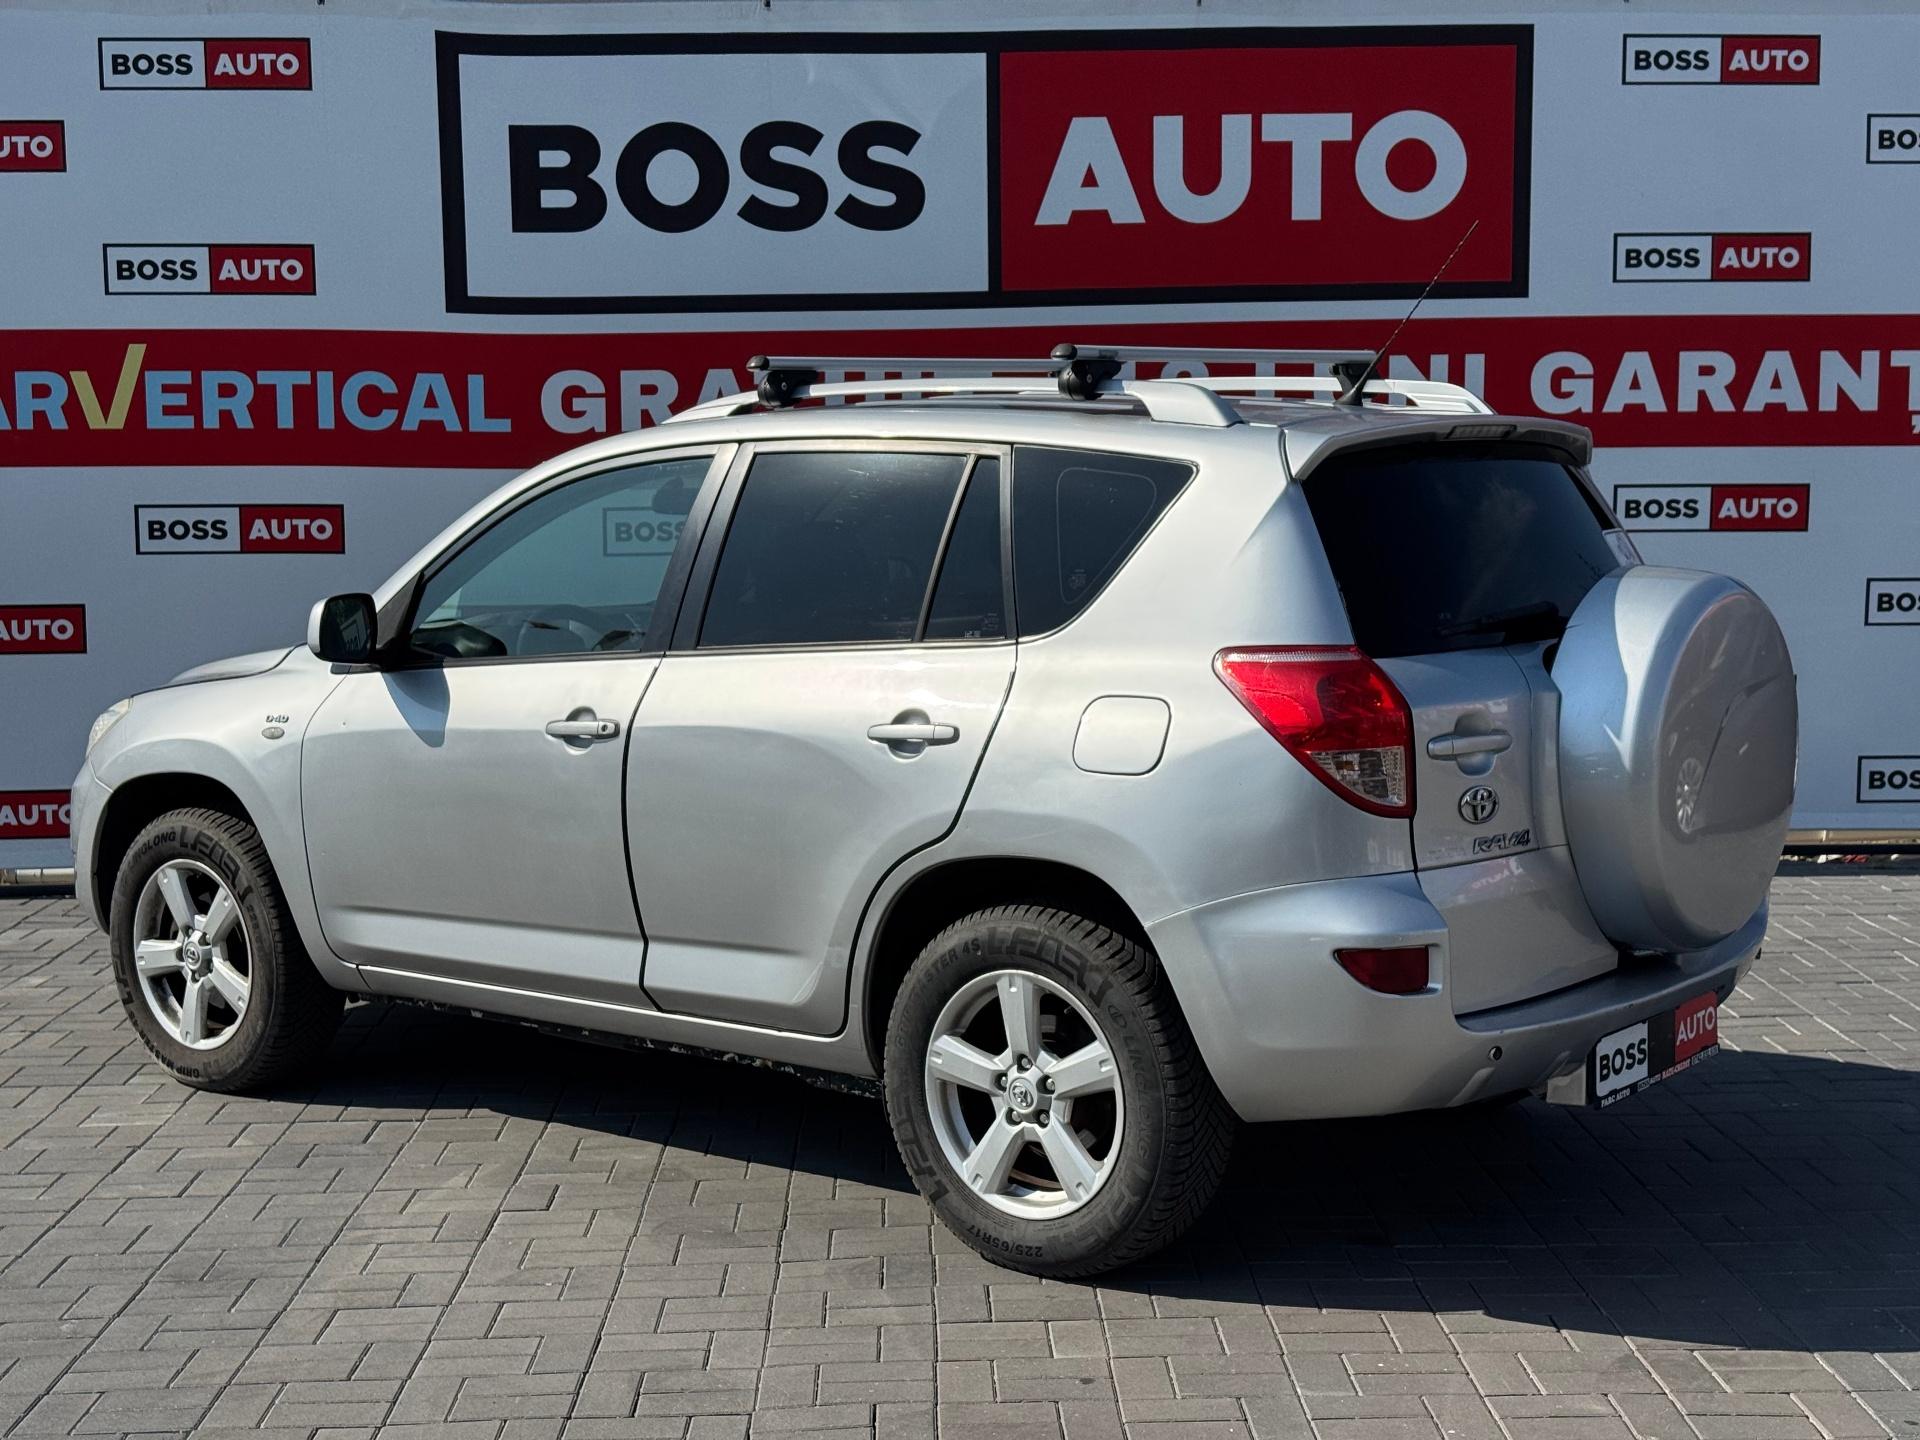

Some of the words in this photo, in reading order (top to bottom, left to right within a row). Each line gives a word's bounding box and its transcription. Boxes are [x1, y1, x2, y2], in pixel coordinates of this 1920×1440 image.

[111, 53, 193, 75] BOSS
[214, 53, 299, 76] AUTO
[1635, 50, 1710, 71] BOSS
[1729, 50, 1810, 71] AUTO
[1878, 129, 1920, 150] BO
[508, 120, 926, 234] BOSS
[1034, 109, 1468, 227] AUTO
[1625, 247, 1700, 269] BOSS
[1719, 247, 1800, 269] AUTO
[116, 259, 198, 281] BOSS
[218, 259, 304, 281] AUTO
[1624, 498, 1699, 519] BOSS
[1718, 497, 1799, 519] AUTO
[147, 519, 228, 541] BOSS
[248, 518, 333, 540] AUTO
[1876, 592, 1920, 613] BO
[1473, 828, 1532, 855] RAV4
[1599, 1037, 1648, 1083] BOSS
[1676, 1006, 1716, 1047] AUTO
[965, 1223, 1044, 1258] 225/65R17
